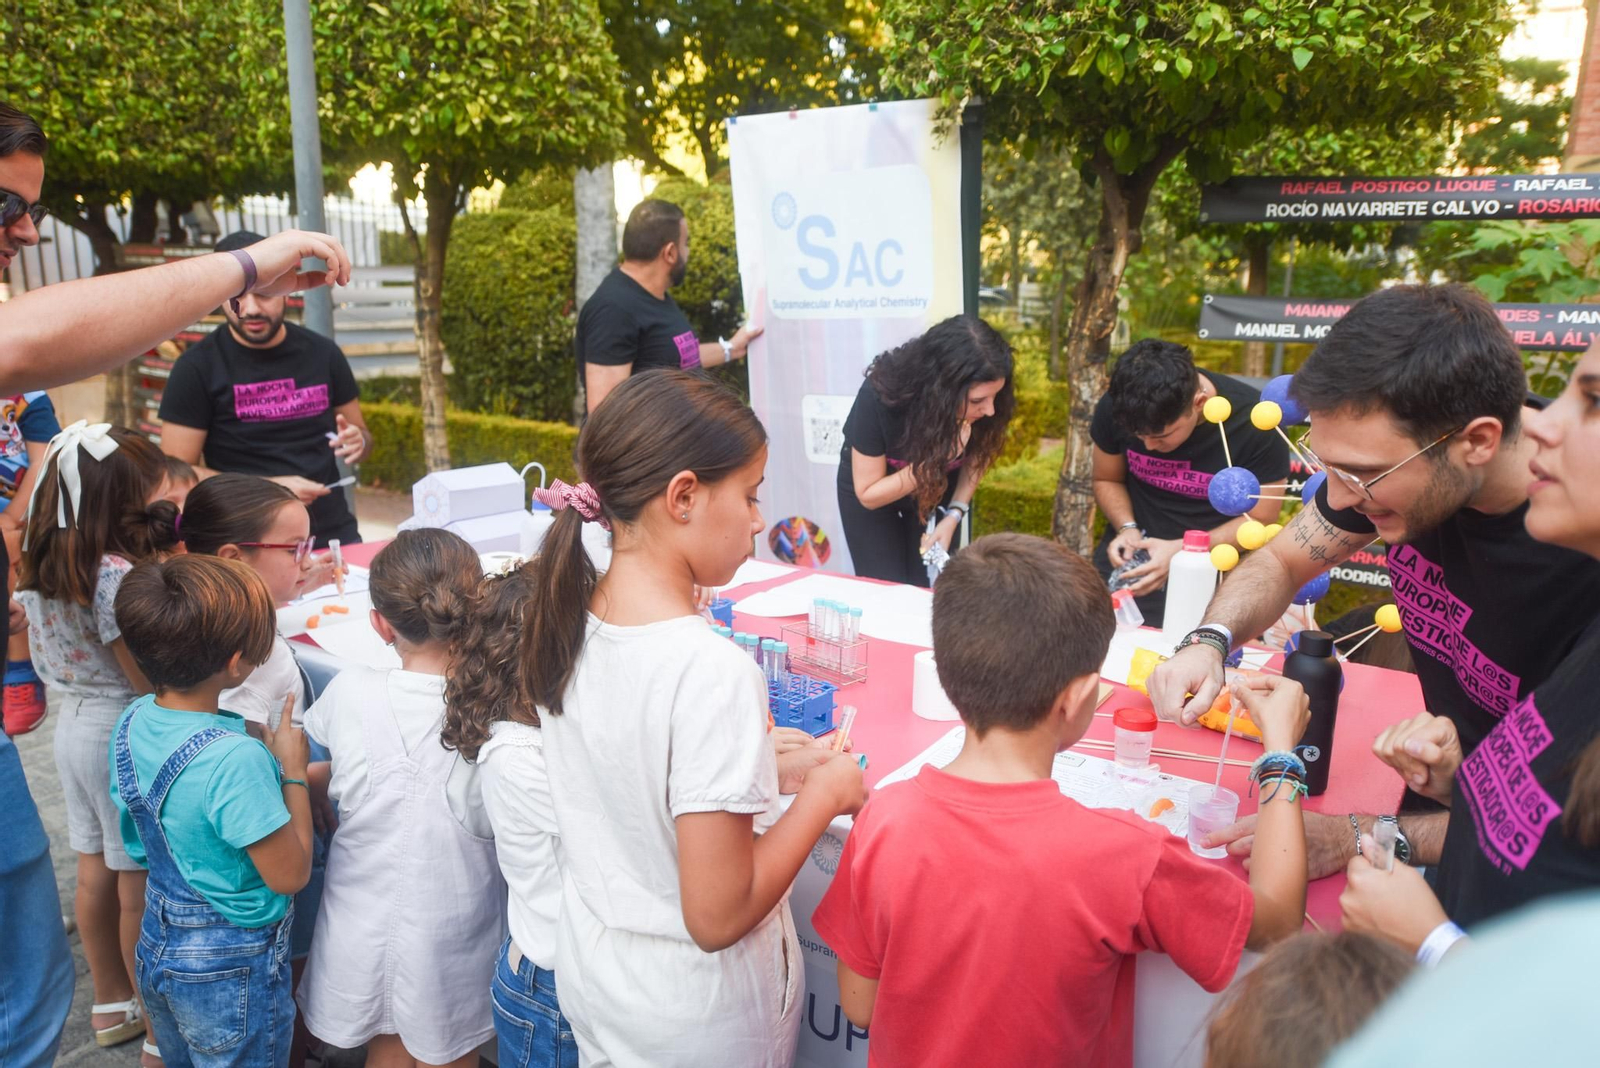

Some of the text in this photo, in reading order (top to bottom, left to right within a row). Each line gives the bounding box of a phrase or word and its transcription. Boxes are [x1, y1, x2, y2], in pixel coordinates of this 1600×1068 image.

[1280, 181, 1346, 195] RAFAEL
[1350, 180, 1432, 194] POSTIGO
[1434, 179, 1497, 193] LUQUE
[1513, 178, 1595, 192] RAFAEL
[1265, 200, 1319, 218] ROCÍO
[1321, 201, 1428, 217] NAVARRETE
[1431, 200, 1500, 215] CALVO
[772, 296, 929, 311] Supramolecular Analytical Chemistry
[1234, 322, 1301, 338] MANUEL
[237, 387, 252, 396] LA
[1128, 452, 1188, 469] LA NOCHE
[1183, 471, 1196, 482] DE
[1392, 546, 1418, 572] LA
[1472, 652, 1512, 692] L@S
[1507, 763, 1528, 795] DE
[1515, 783, 1549, 826] L@S
